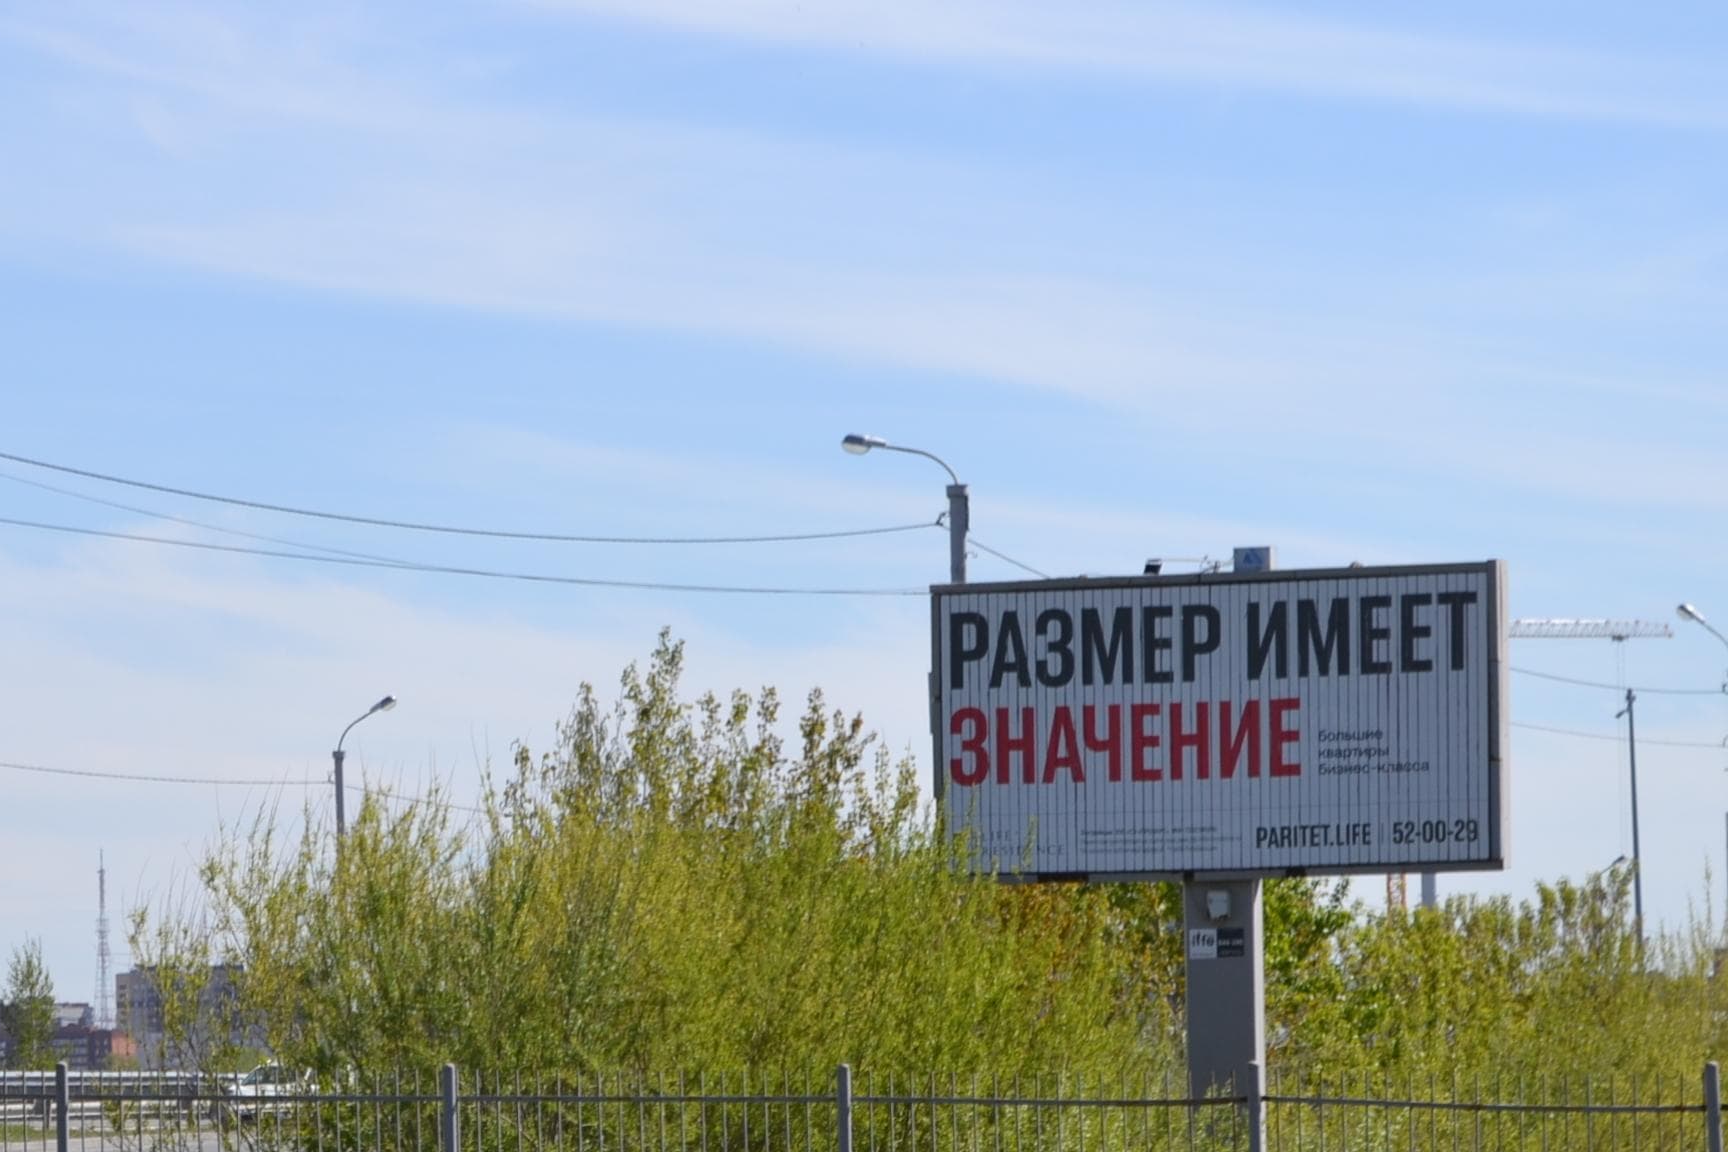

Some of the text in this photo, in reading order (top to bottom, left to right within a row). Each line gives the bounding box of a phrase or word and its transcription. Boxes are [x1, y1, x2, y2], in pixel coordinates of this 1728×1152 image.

[949, 590, 1478, 690] РАЗМЕР ИМЕЕТ
[949, 697, 1302, 788] ЗНАЧЕНИЕ
[1318, 746, 1390, 760] квартиры
[1255, 819, 1479, 849] PARITET.LIFE 52-00-29
